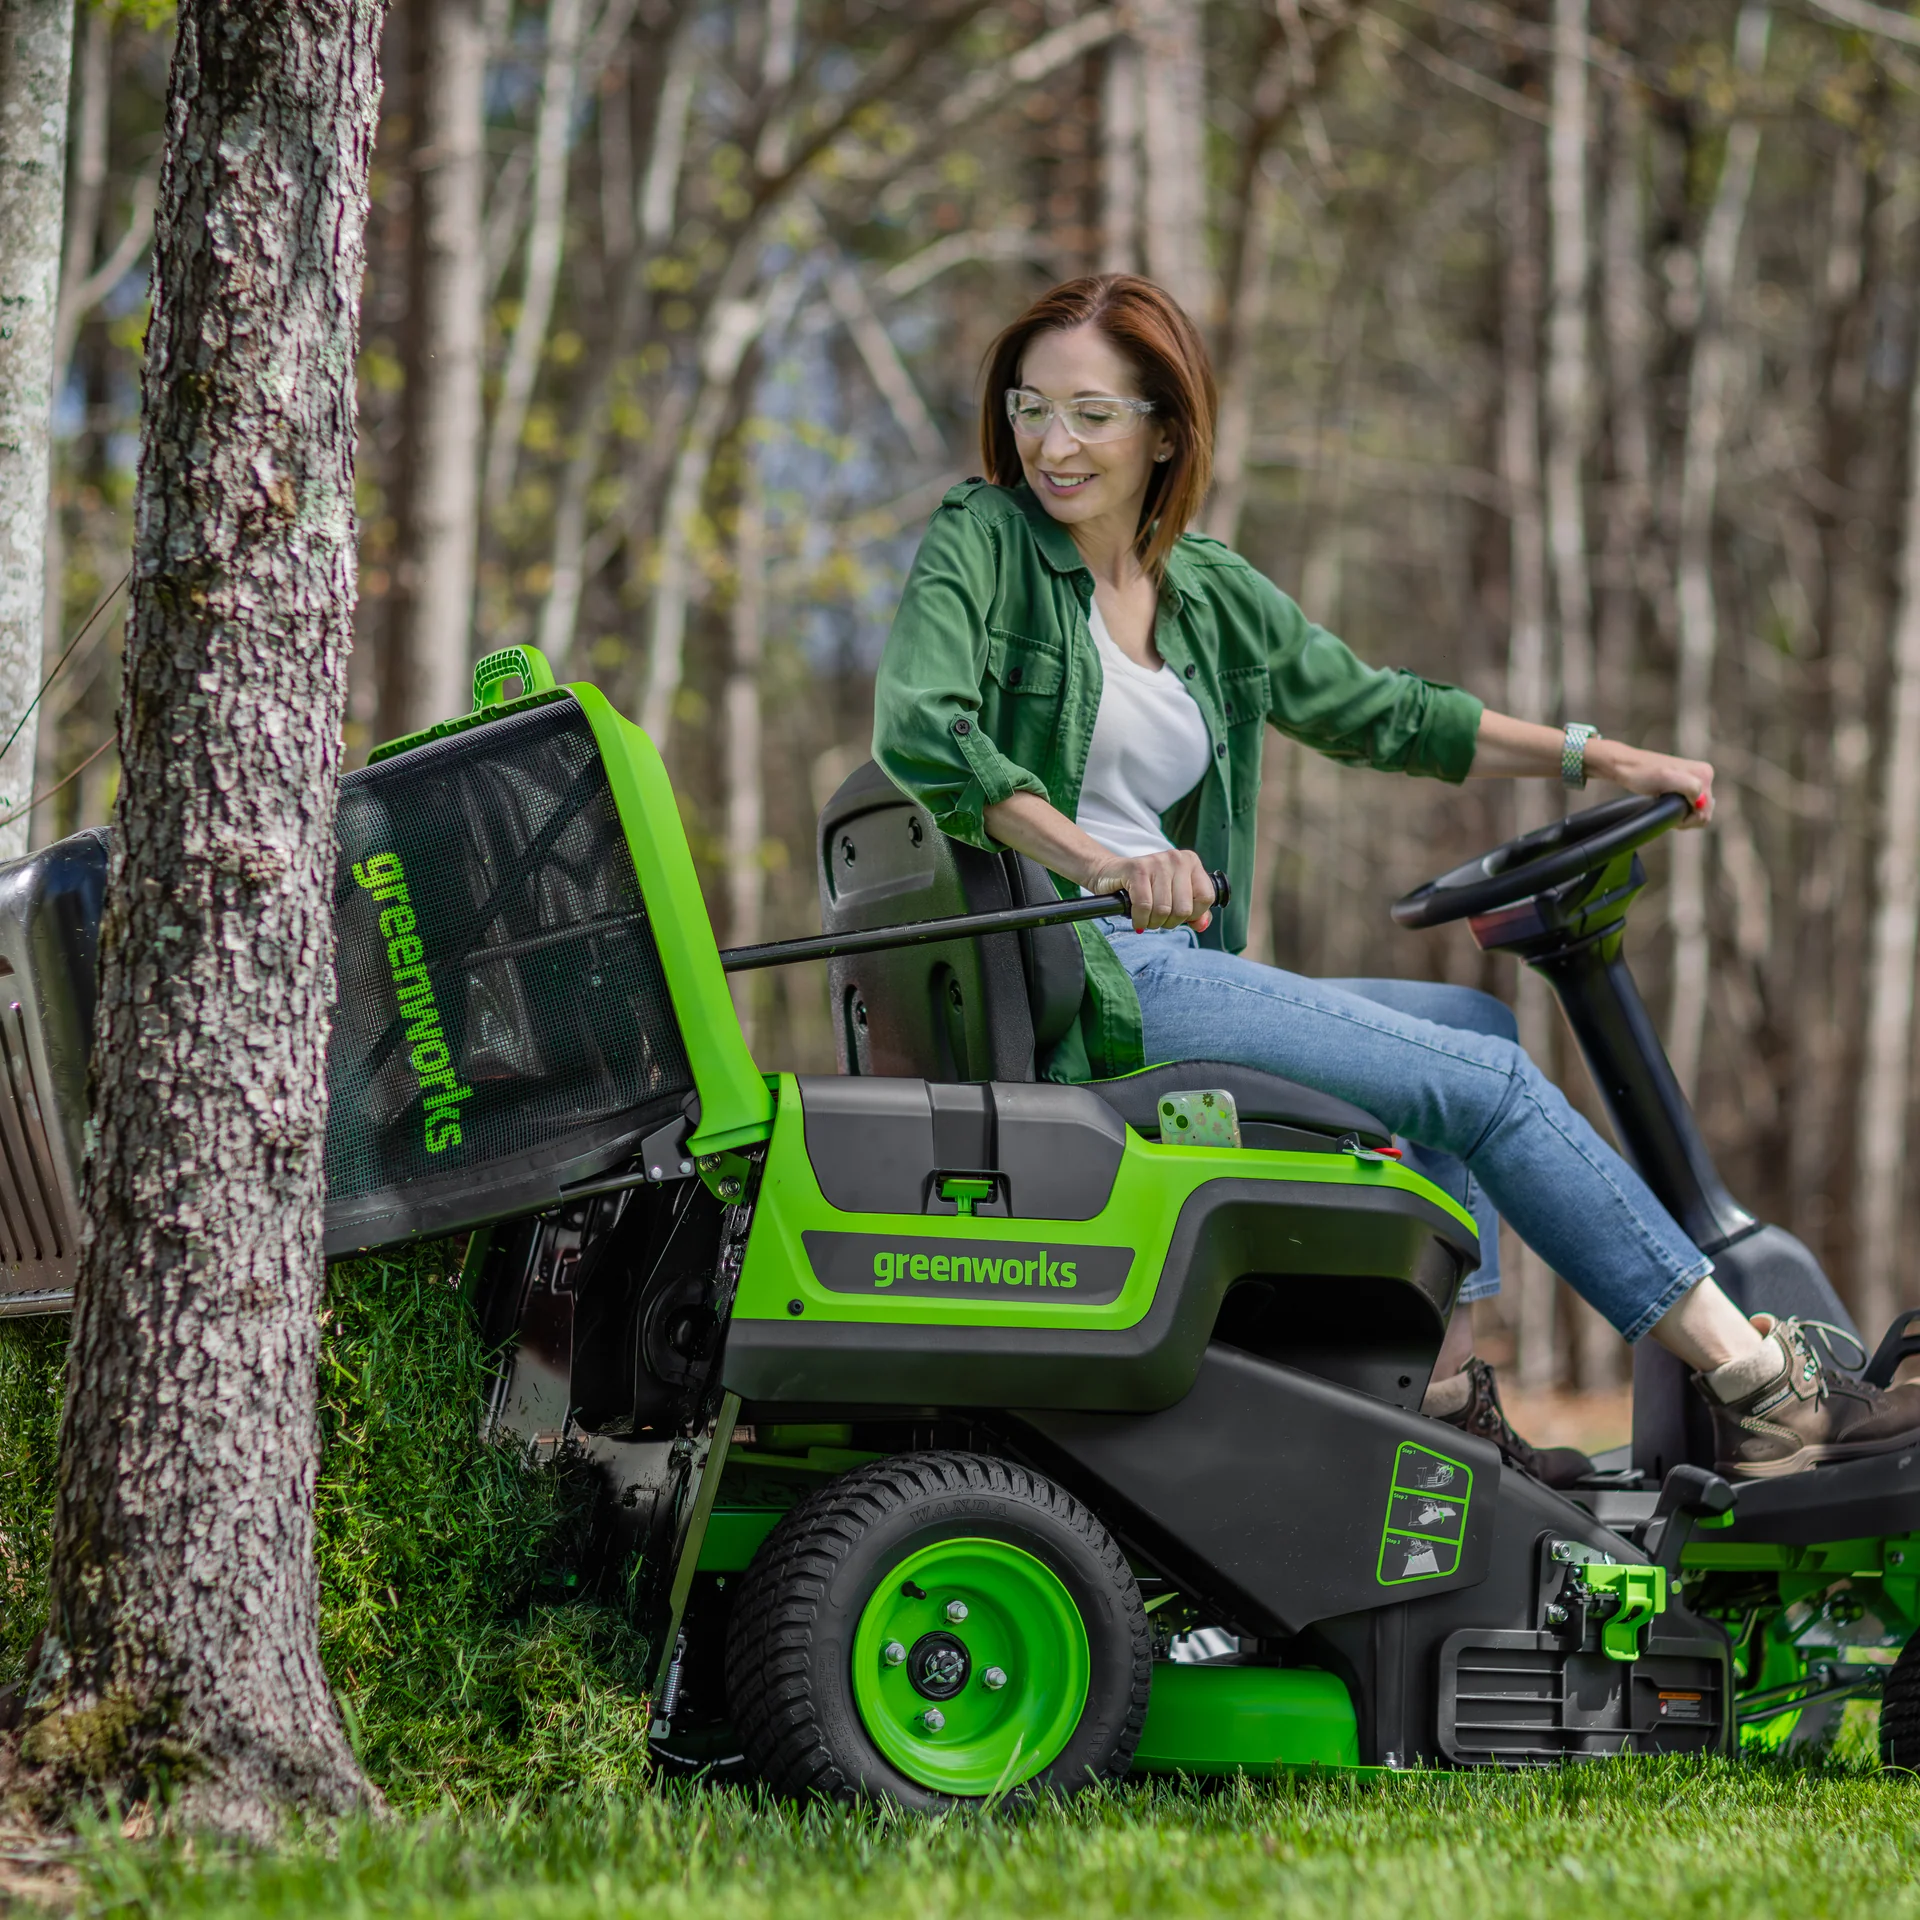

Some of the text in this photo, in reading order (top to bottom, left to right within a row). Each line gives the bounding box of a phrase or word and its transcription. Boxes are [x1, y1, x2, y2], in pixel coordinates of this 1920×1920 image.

[352, 852, 473, 1153] greenworks
[874, 1251, 1076, 1288] greenworks
[910, 1499, 1007, 1524] WANDA
[1386, 1537, 1396, 1545] Step
